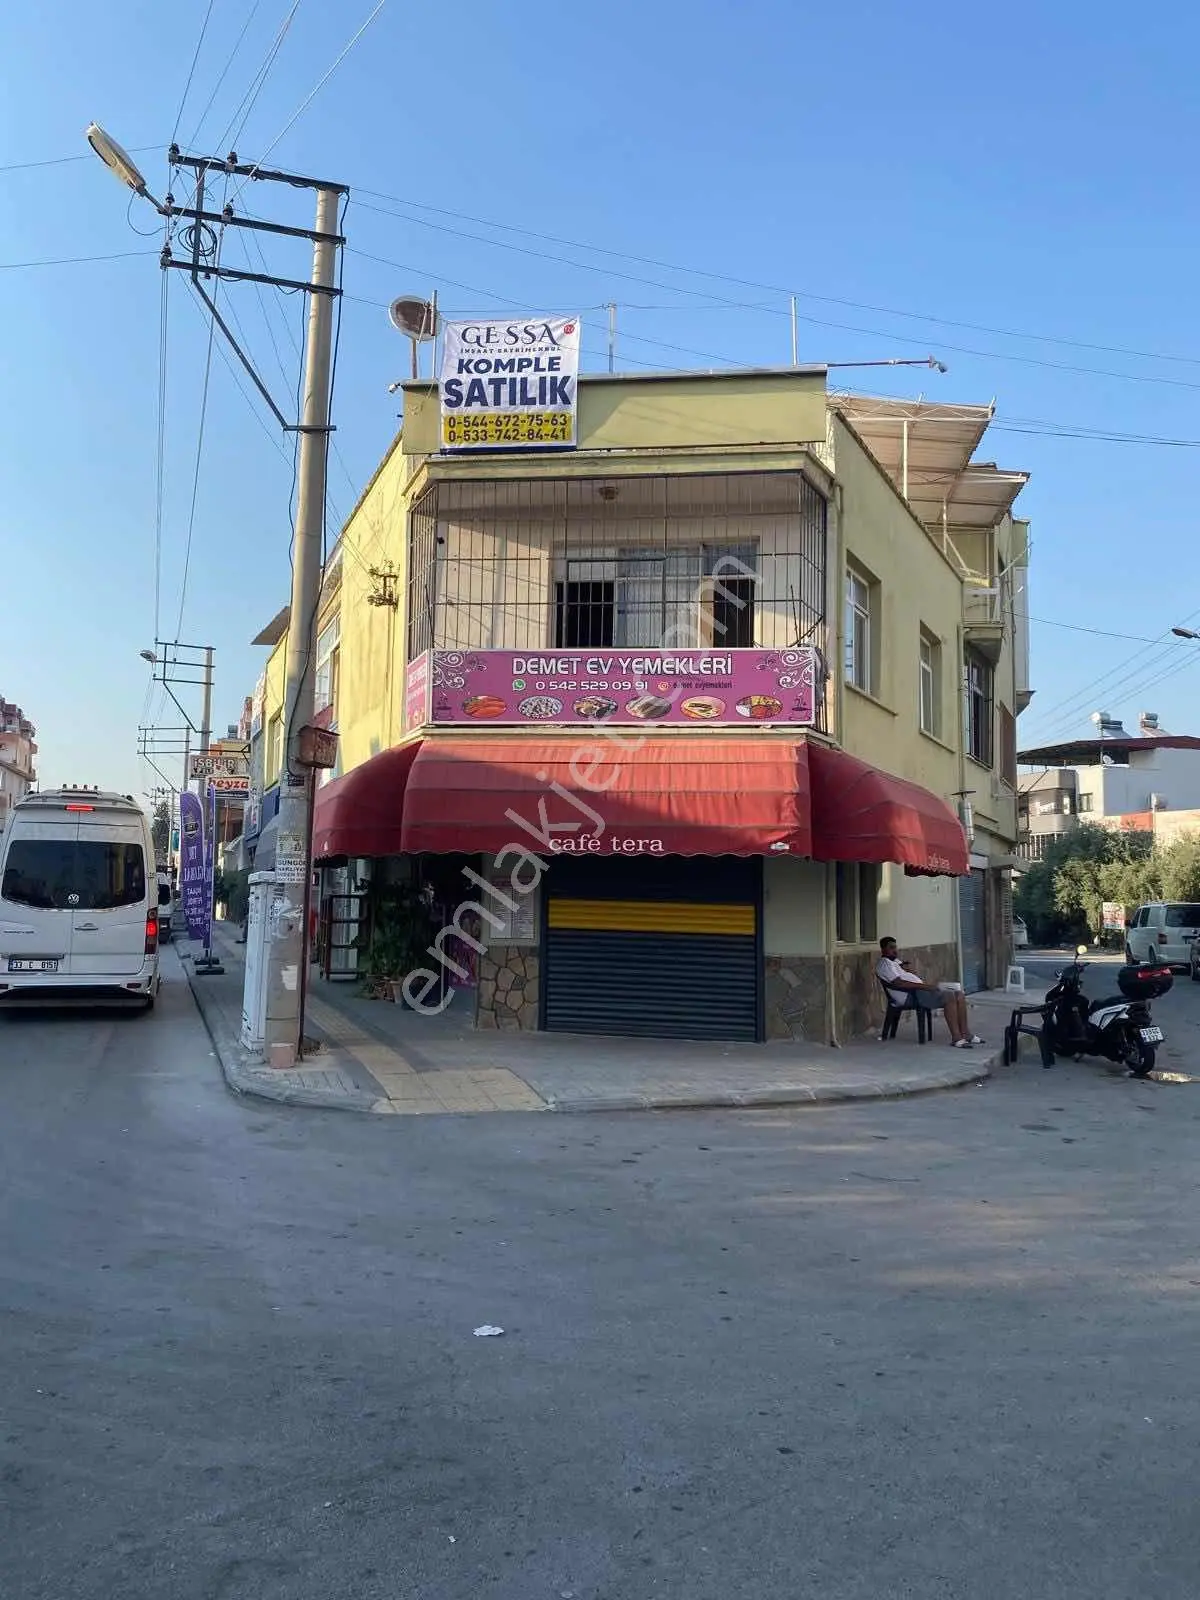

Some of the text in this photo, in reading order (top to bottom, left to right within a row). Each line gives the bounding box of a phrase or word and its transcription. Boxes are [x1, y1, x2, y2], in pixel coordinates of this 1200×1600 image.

[461, 323, 561, 348] GESSA
[457, 356, 562, 374] KOMPLE
[444, 375, 572, 408] SATILIK
[448, 414, 568, 428] 0-544-672-75-63
[448, 428, 567, 442] 0-533-742-84-41
[512, 653, 733, 675] DEMET EV YEMEKLERİ
[535, 681, 648, 690] 0 542 529 09 91
[548, 833, 664, 851] cafe tera
